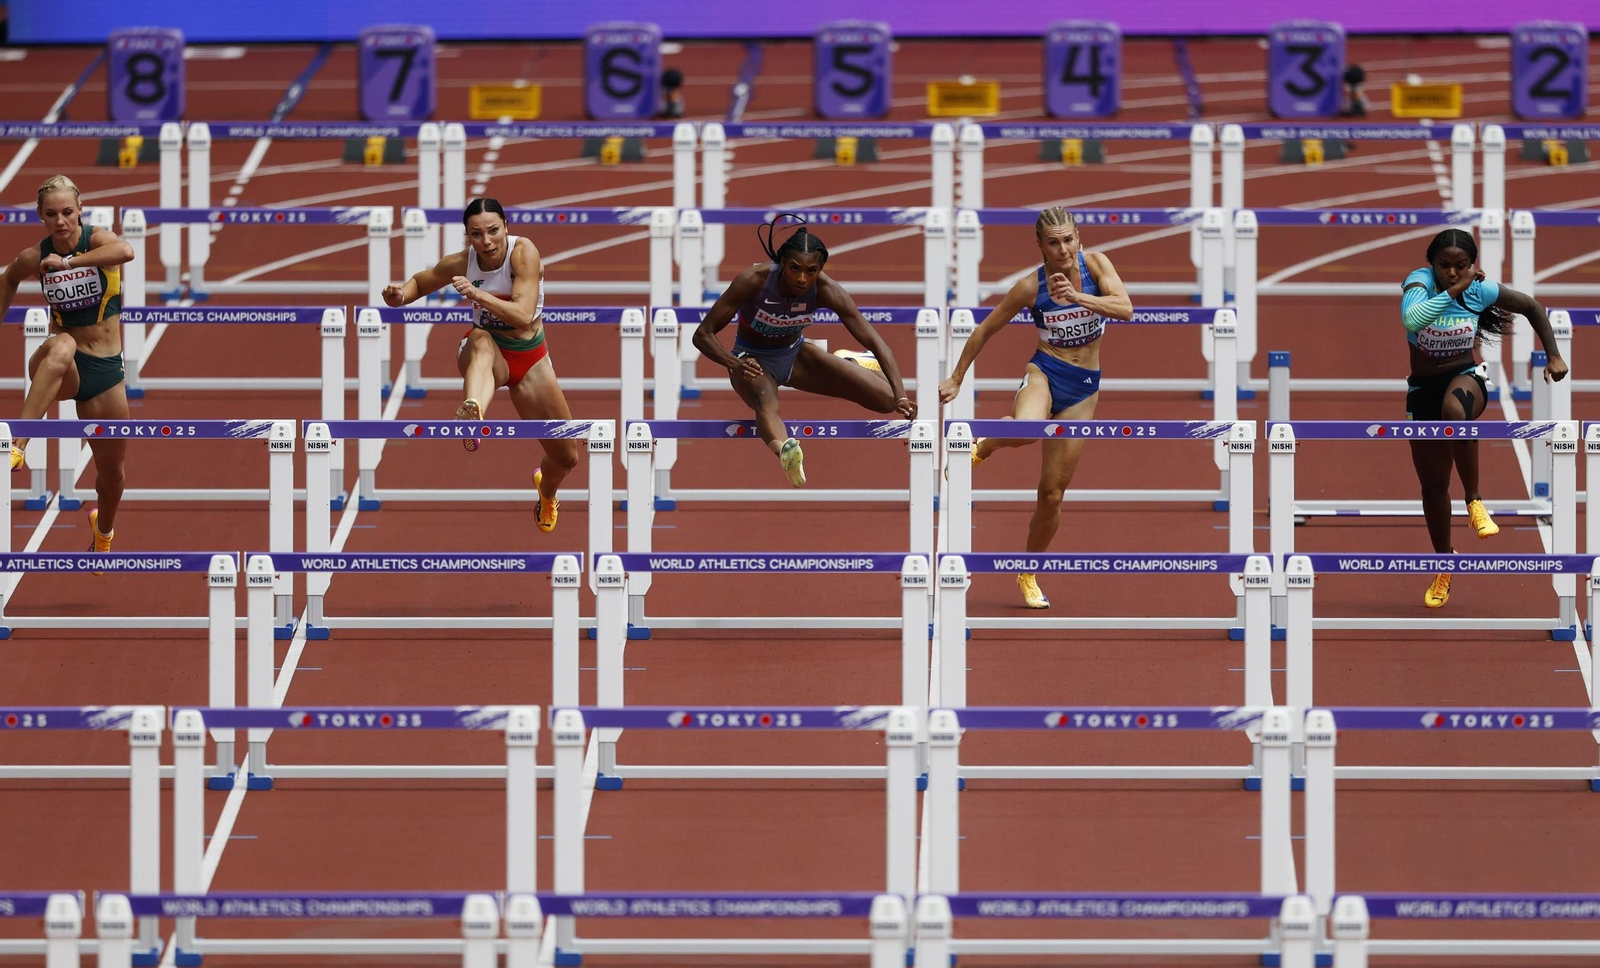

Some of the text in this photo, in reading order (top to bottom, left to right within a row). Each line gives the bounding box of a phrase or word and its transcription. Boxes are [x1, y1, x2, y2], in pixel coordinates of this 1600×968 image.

[375, 48, 417, 102] 7
[601, 47, 644, 100] 6
[833, 46, 875, 98] 5
[1061, 45, 1106, 97] 4
[1285, 45, 1327, 97] 3
[1529, 45, 1571, 100] 2
[125, 52, 166, 106] 8
[44, 268, 97, 285] HONDA
[47, 281, 99, 302] FOURIE
[120, 312, 297, 322] RLD ATHLETICS CHAMPIONSHIPS
[403, 312, 442, 322] WORLD
[541, 312, 597, 322] PIONSHIPS
[757, 311, 812, 326] HONDA
[813, 312, 893, 322] HAMPSHIPS
[1010, 313, 1034, 323] RLD
[1045, 310, 1094, 324] HOND
[1433, 316, 1478, 327] HAMS
[952, 327, 972, 335] NISHI
[1051, 317, 1099, 339] FORSTER
[1215, 327, 1235, 335] NISHI
[1420, 334, 1473, 349] CARTWRIGHT
[750, 426, 838, 437] TYO25
[7, 558, 182, 570] ATHLETICS CHAMPIONSHIPS
[301, 558, 526, 570] WORLD ATHLETICS CHAMPIONSHIPS
[649, 558, 874, 570] WORLD ATHLETICS CHAMPIONSHIPS
[993, 559, 1218, 571] WORLD ATHLETICS CHAMPIONSHIPS
[1339, 559, 1563, 571] WORLD ATHLETICS CHAMPIONSHIPS
